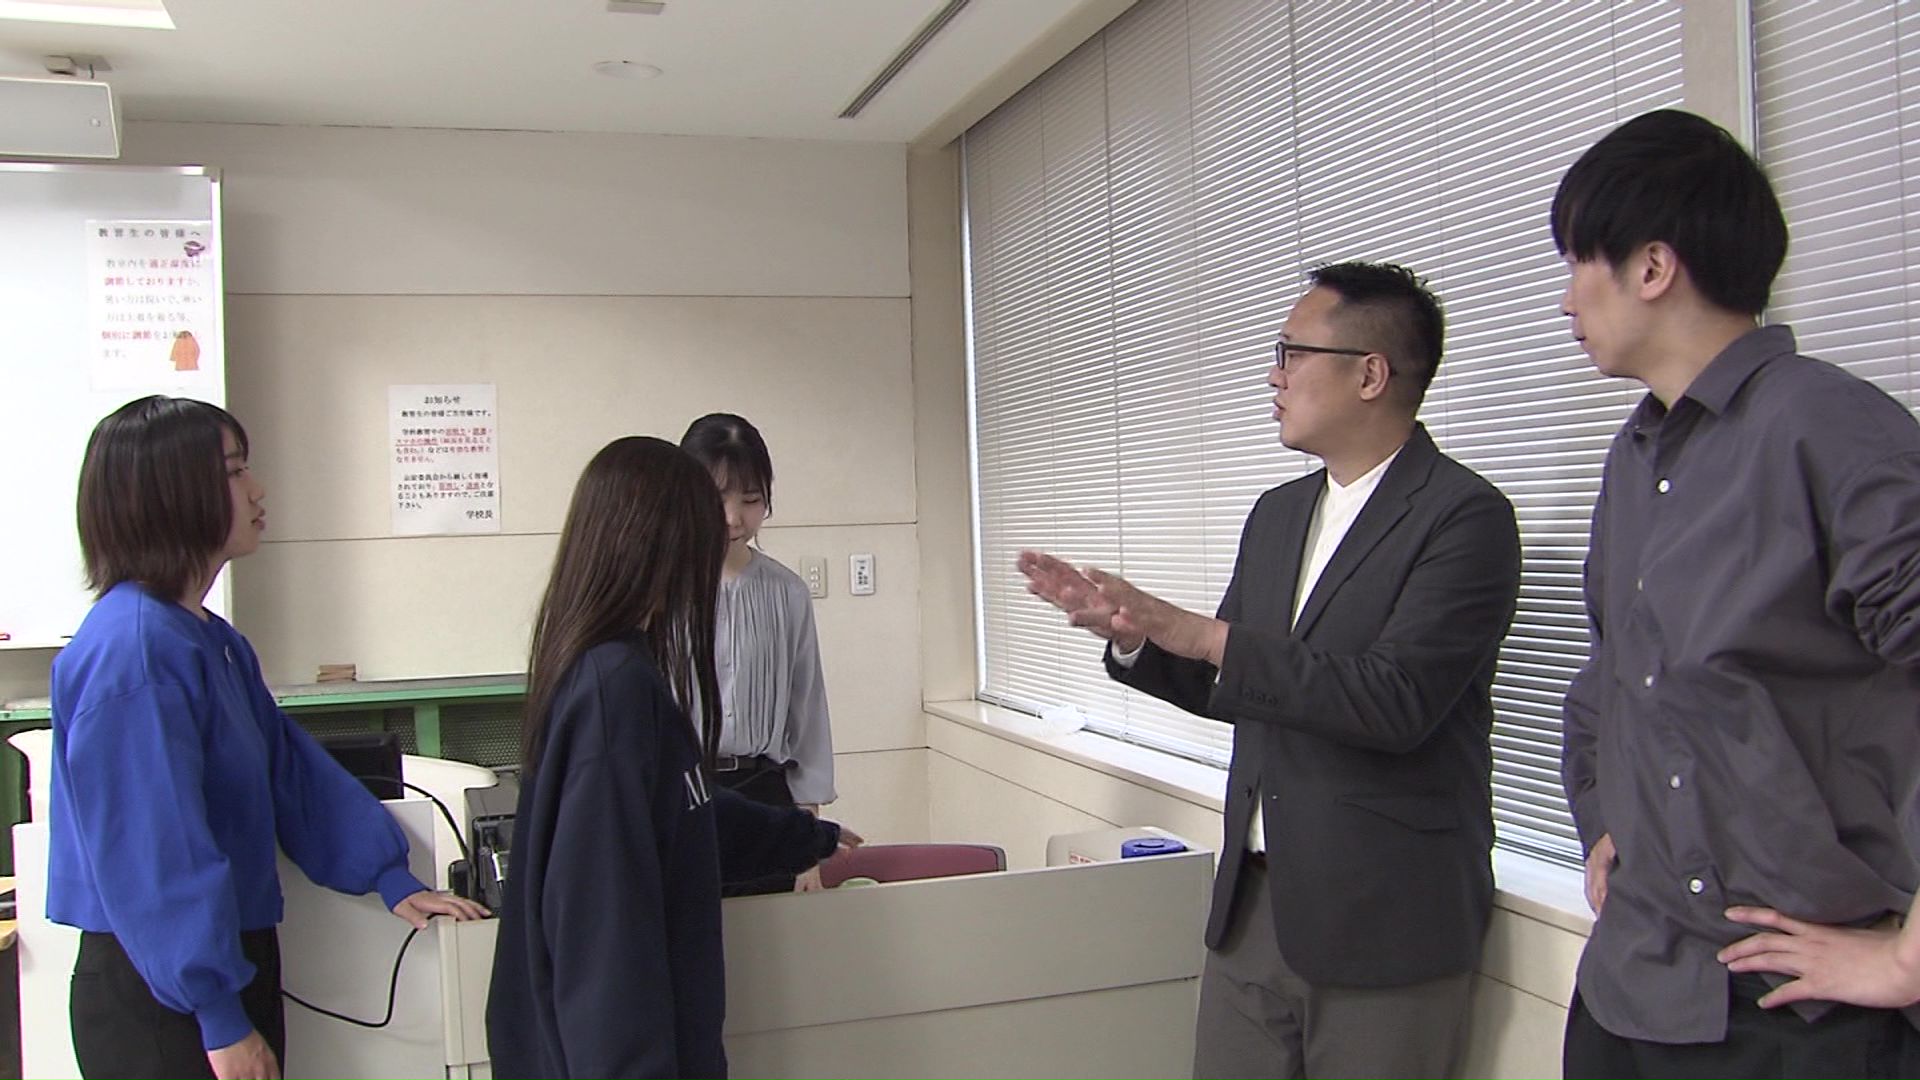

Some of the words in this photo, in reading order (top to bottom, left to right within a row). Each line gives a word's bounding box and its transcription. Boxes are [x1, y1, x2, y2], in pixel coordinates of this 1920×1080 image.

[98, 228, 201, 238] 教習生の皆様へ
[424, 396, 461, 404] お知らせ
[466, 510, 493, 519] 学校長
